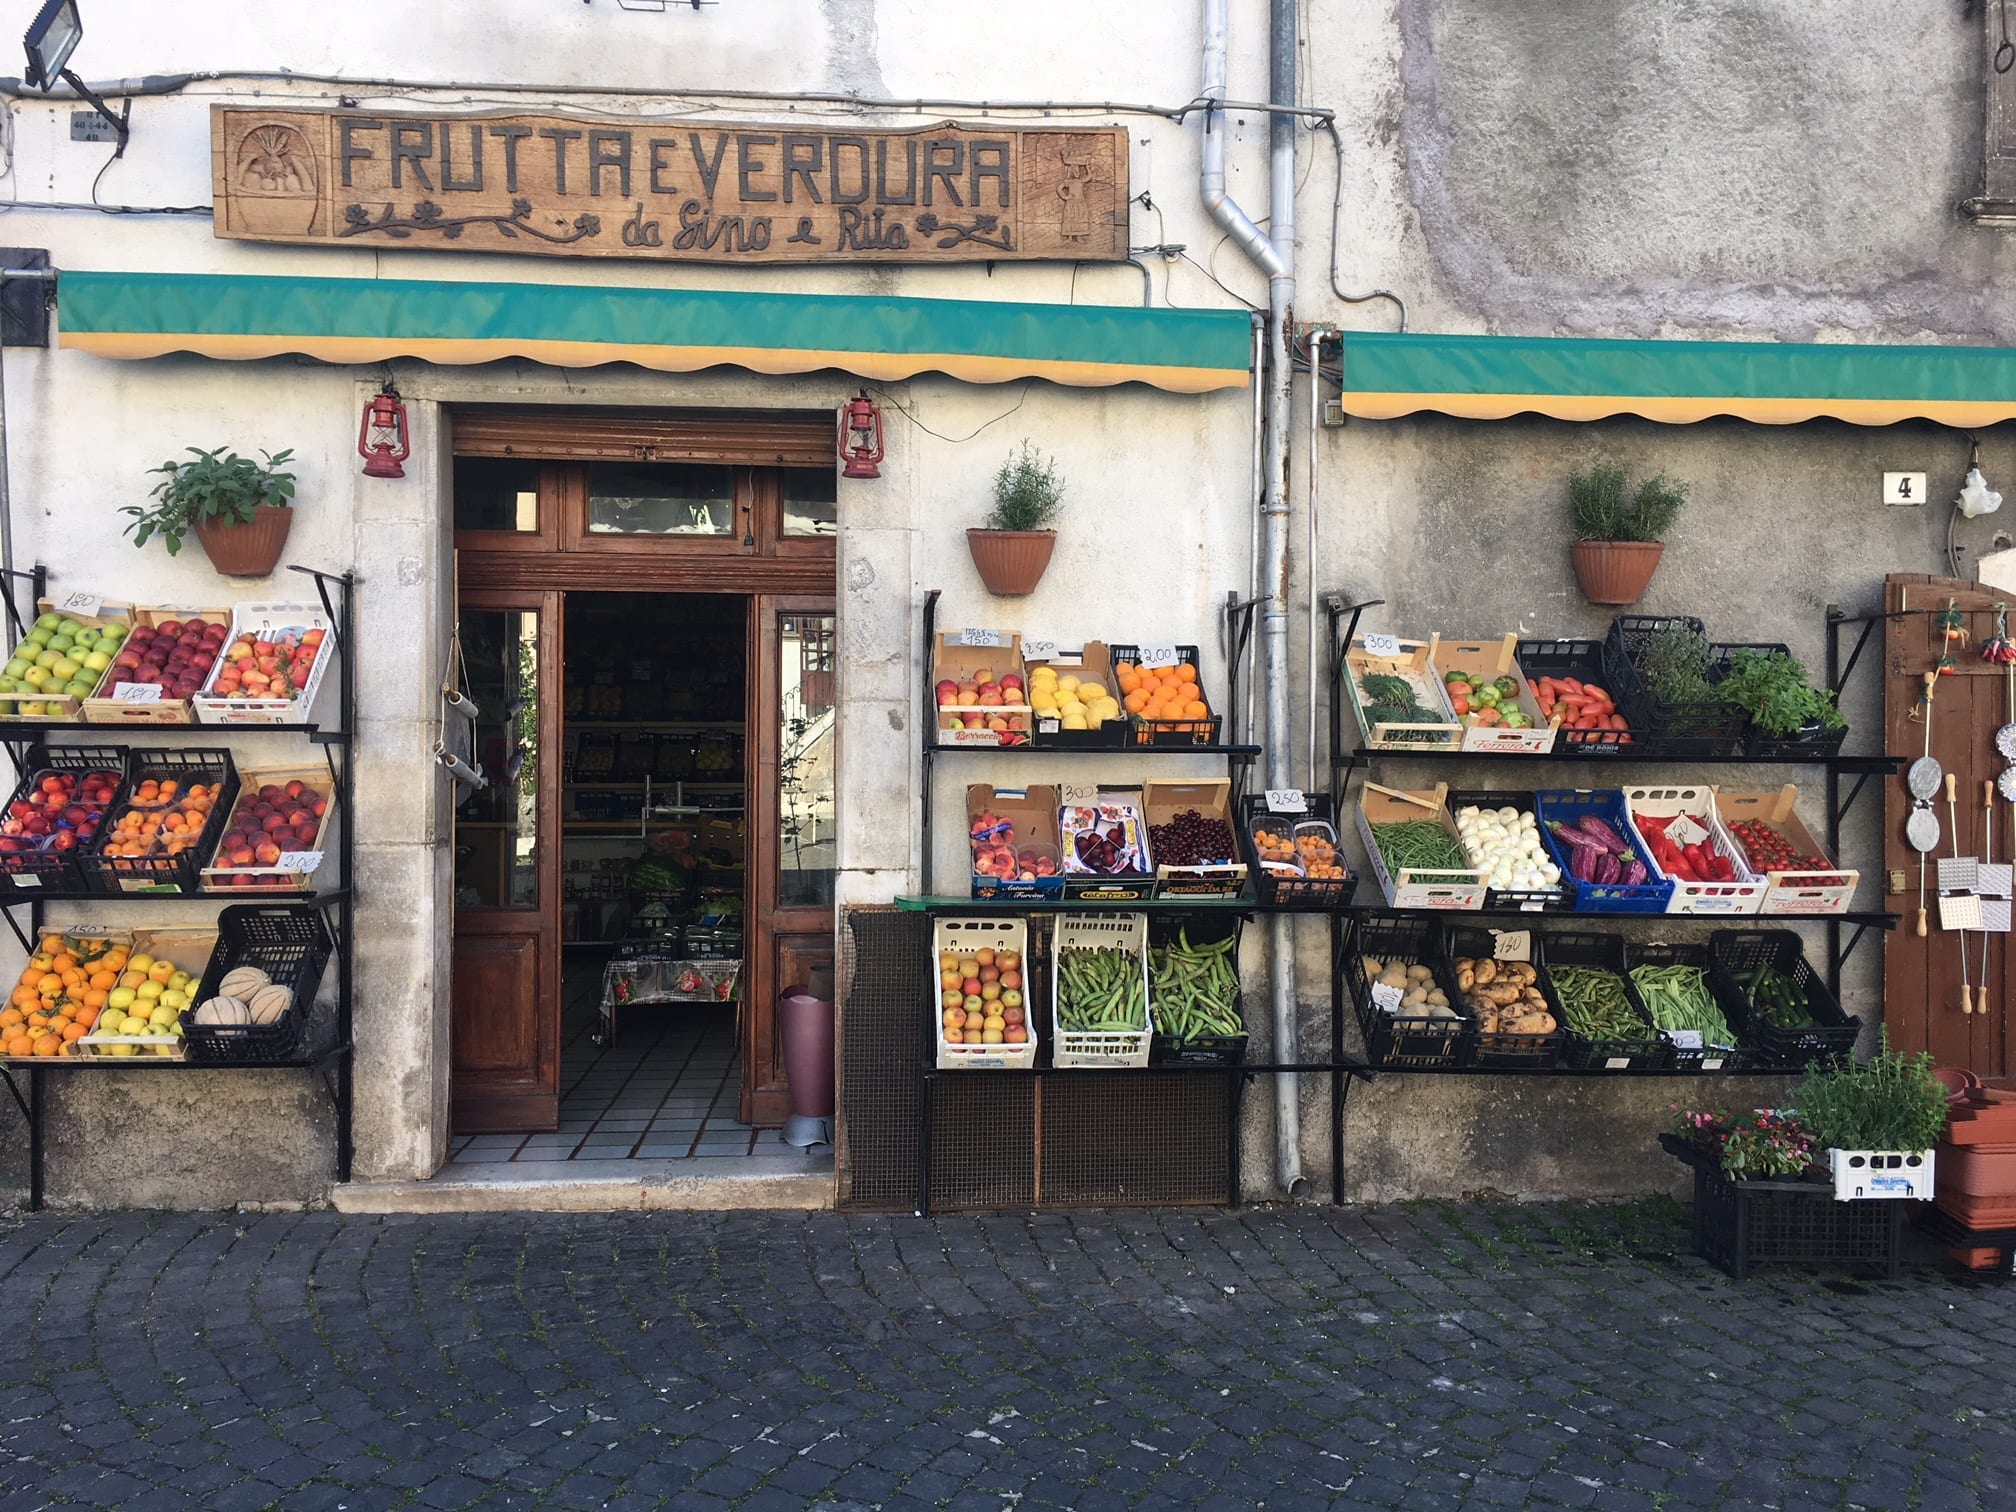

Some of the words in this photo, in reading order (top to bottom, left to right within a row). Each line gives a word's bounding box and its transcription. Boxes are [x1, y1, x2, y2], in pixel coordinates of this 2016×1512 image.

[338, 118, 632, 197] FRUTTA
[650, 138, 677, 195] E
[689, 132, 1011, 208] VERDURA
[621, 201, 664, 247] da
[672, 199, 773, 252] Gino
[787, 215, 822, 245] e
[1898, 477, 1912, 498] 4
